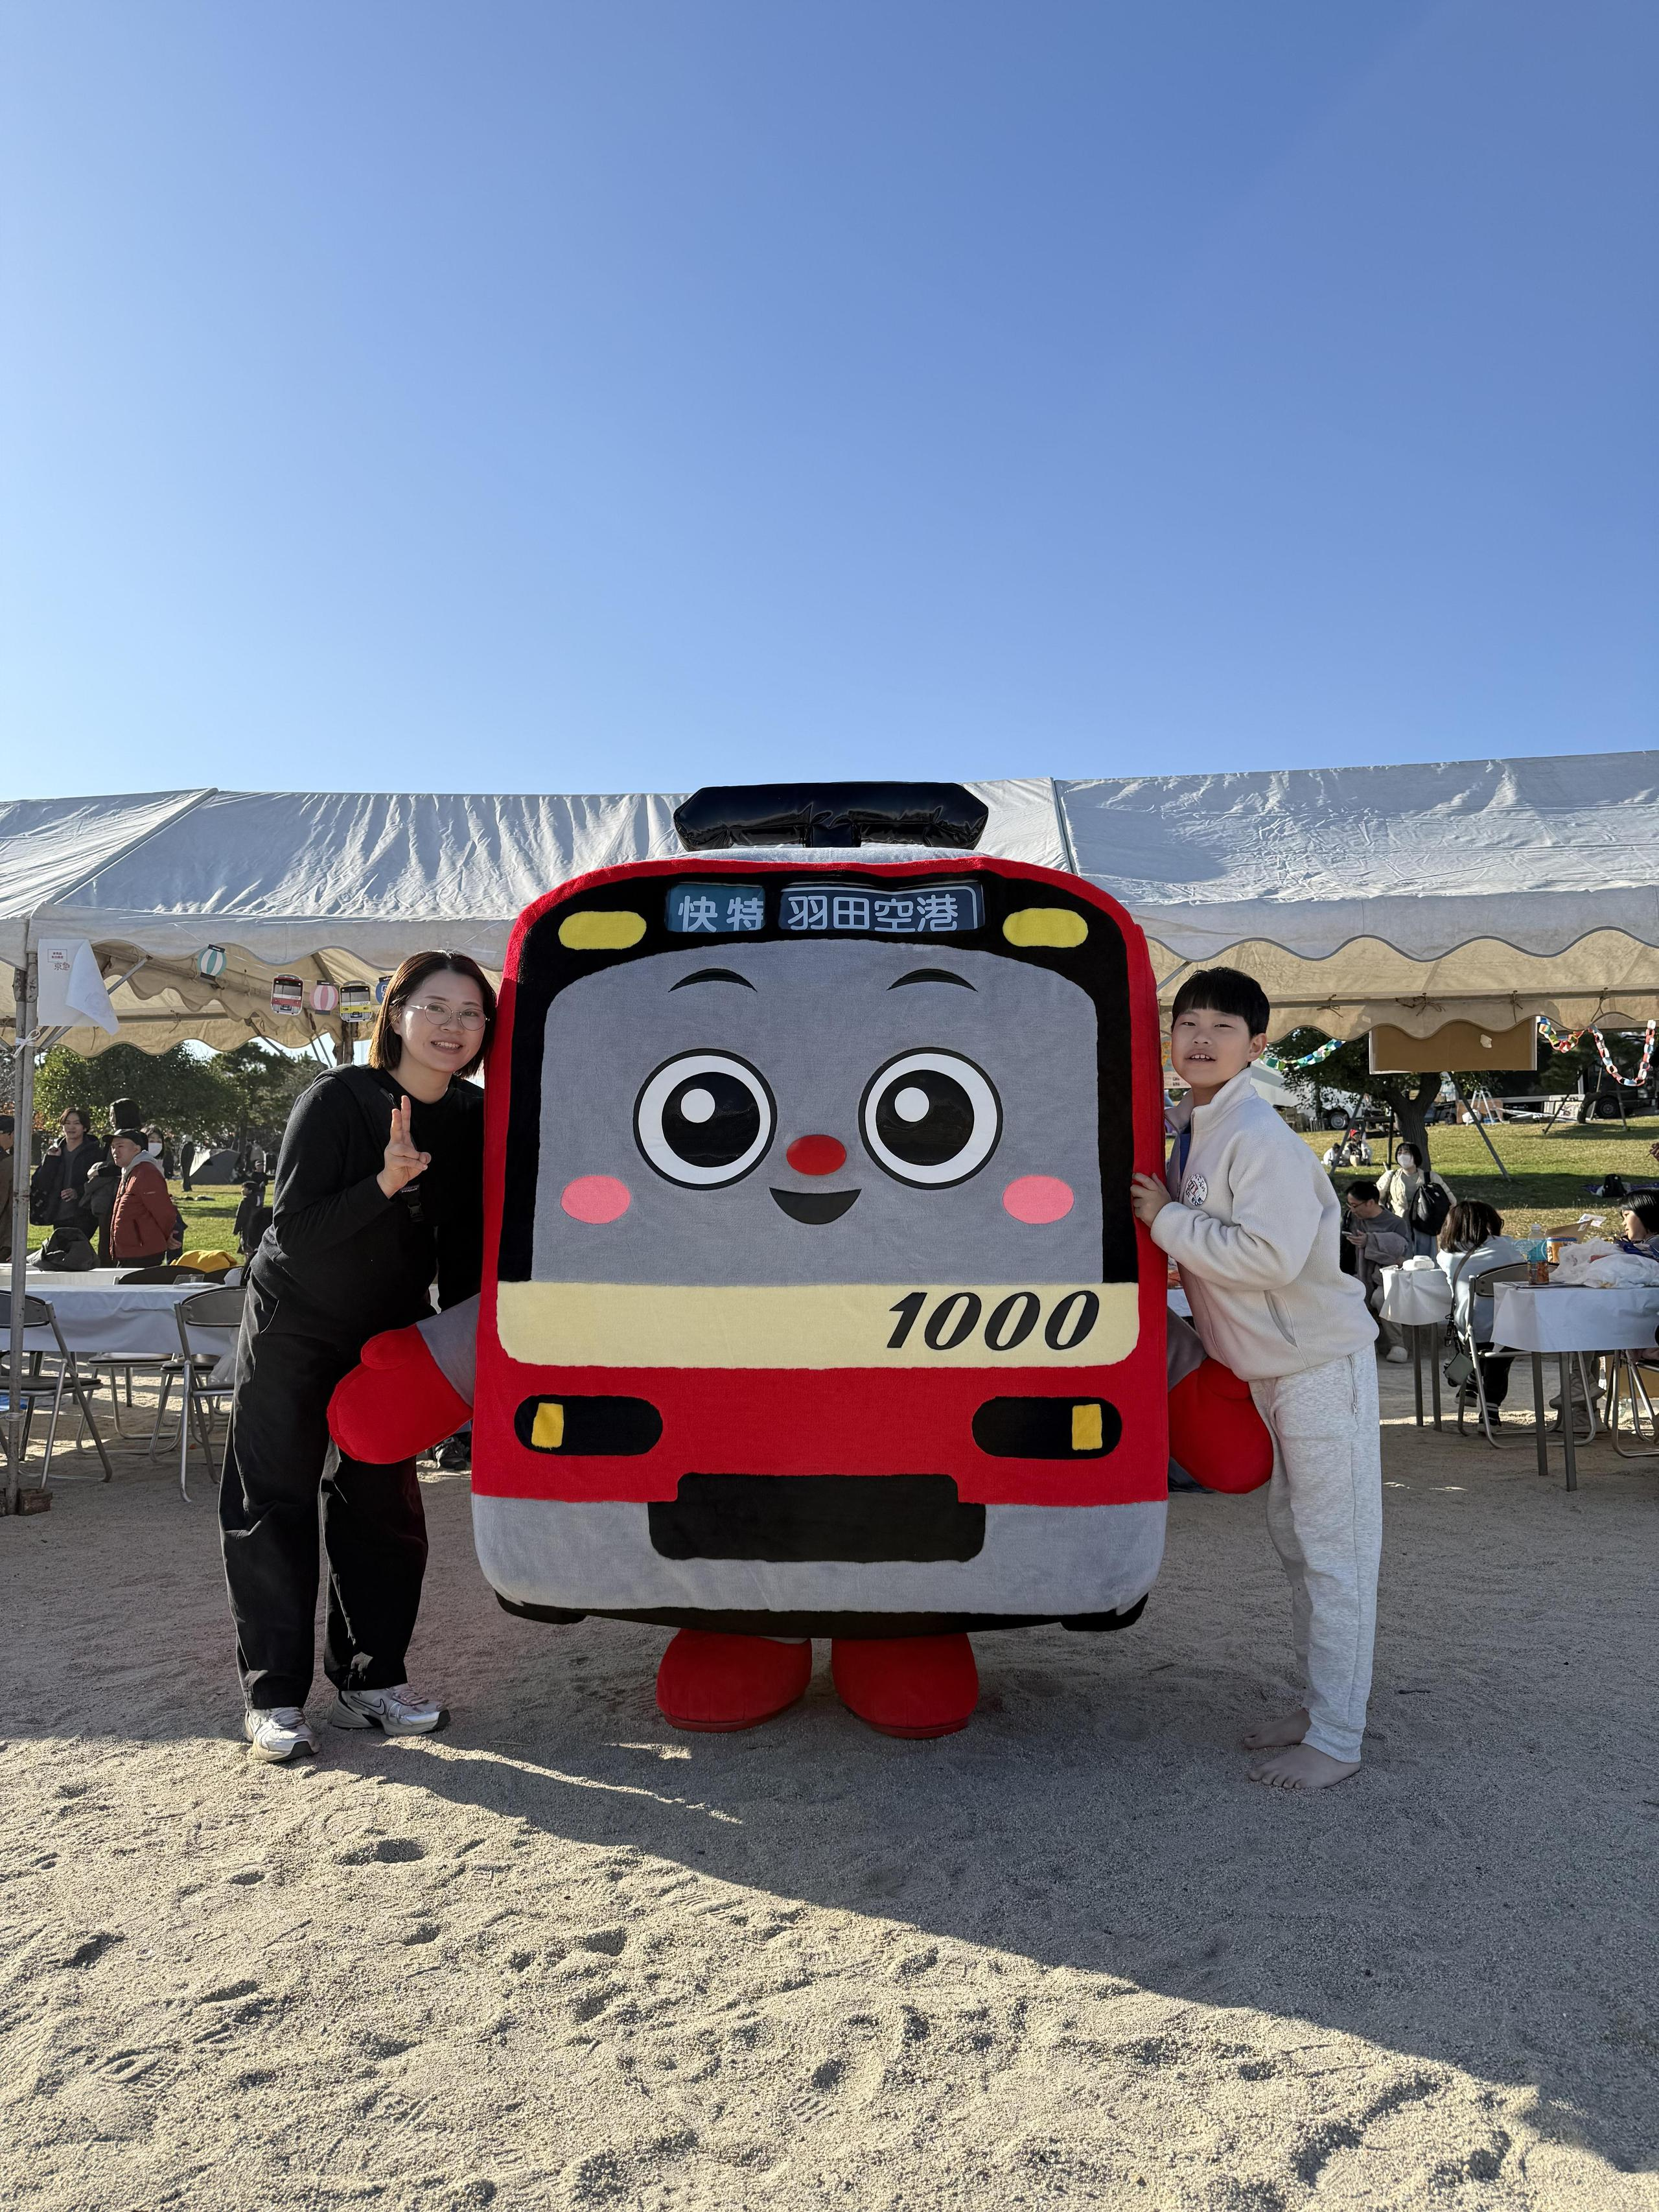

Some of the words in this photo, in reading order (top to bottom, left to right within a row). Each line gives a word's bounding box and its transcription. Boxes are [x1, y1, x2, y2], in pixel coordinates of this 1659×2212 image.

[678, 895, 765, 933] 快特
[787, 894, 958, 933] 羽田空港
[887, 1290, 1100, 1351] 1000
